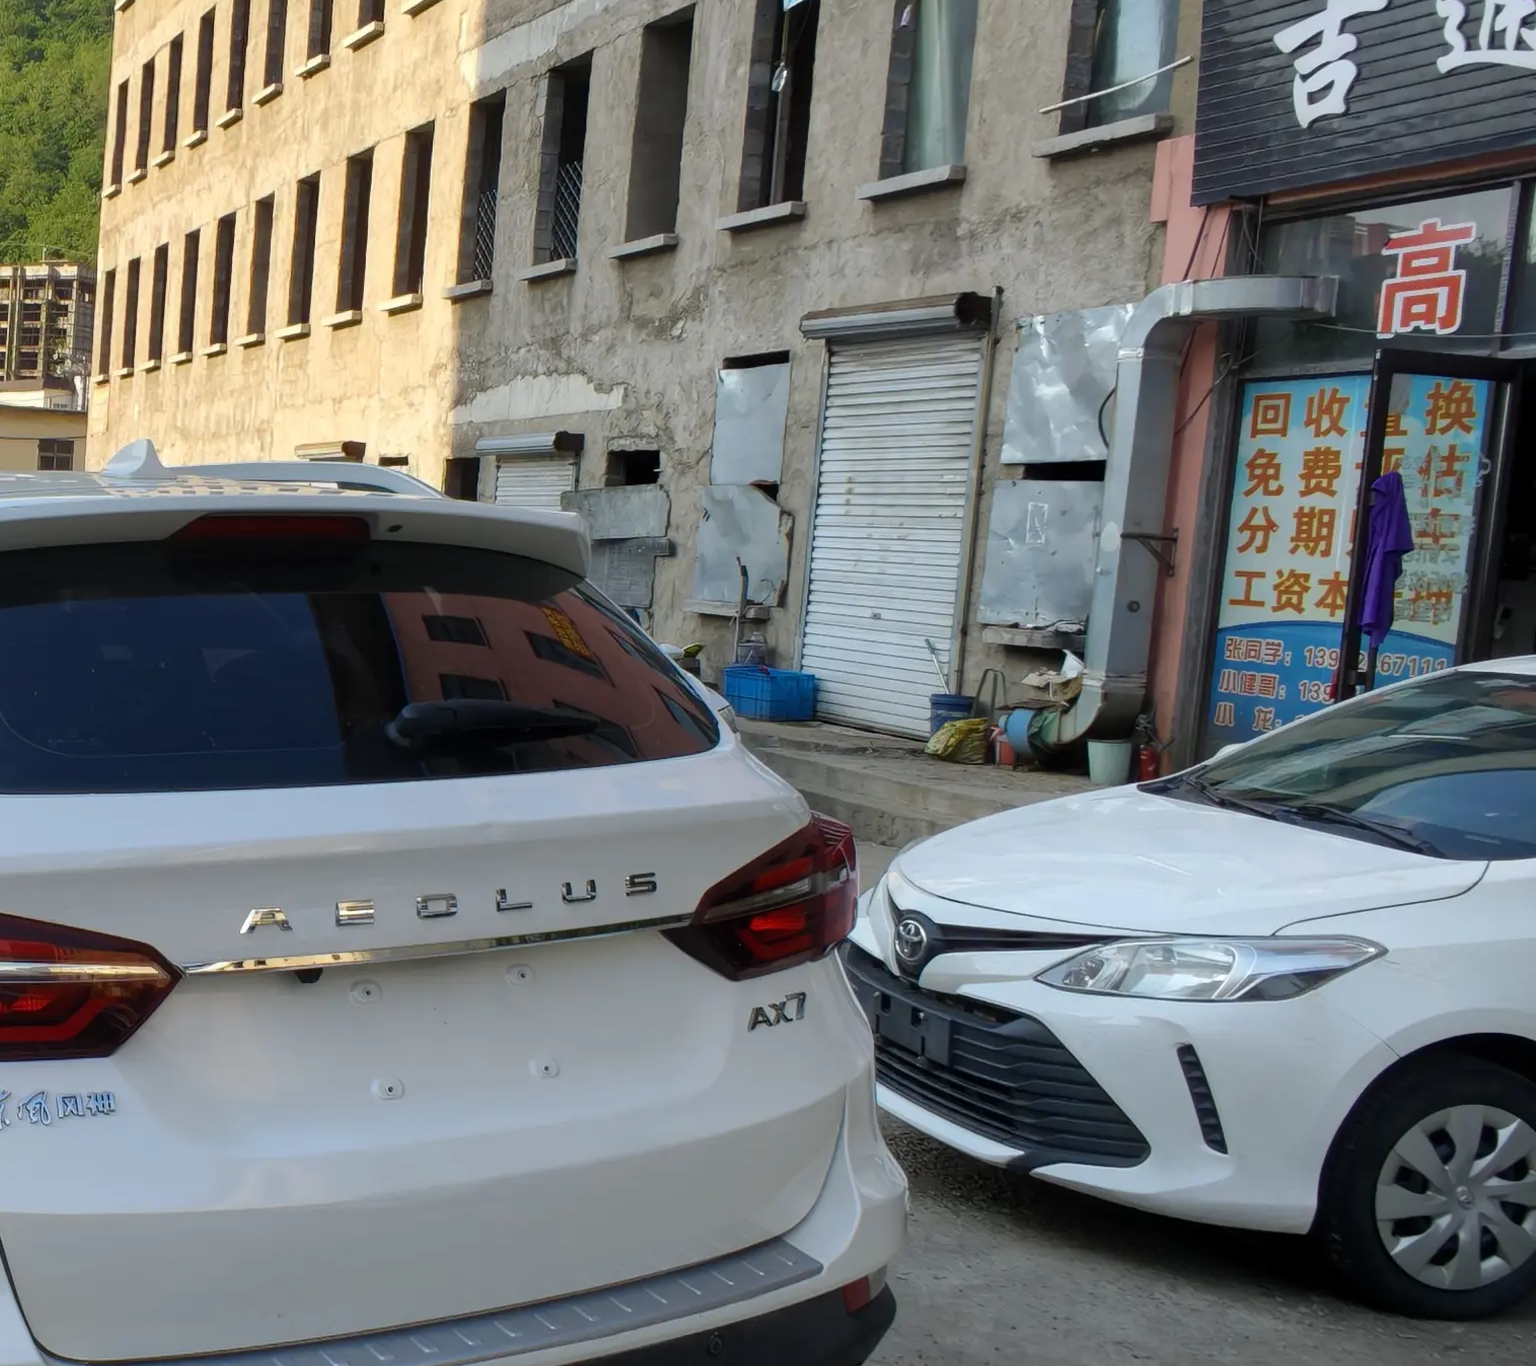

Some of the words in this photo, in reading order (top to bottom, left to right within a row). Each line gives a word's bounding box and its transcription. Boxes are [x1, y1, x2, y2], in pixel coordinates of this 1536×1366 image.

[1377, 218, 1476, 339] 高
[1236, 506, 1461, 557] 分期车
[1229, 568, 1455, 626] 工资本押
[239, 872, 658, 935] AEOLUS
[747, 991, 806, 1033] AX7
